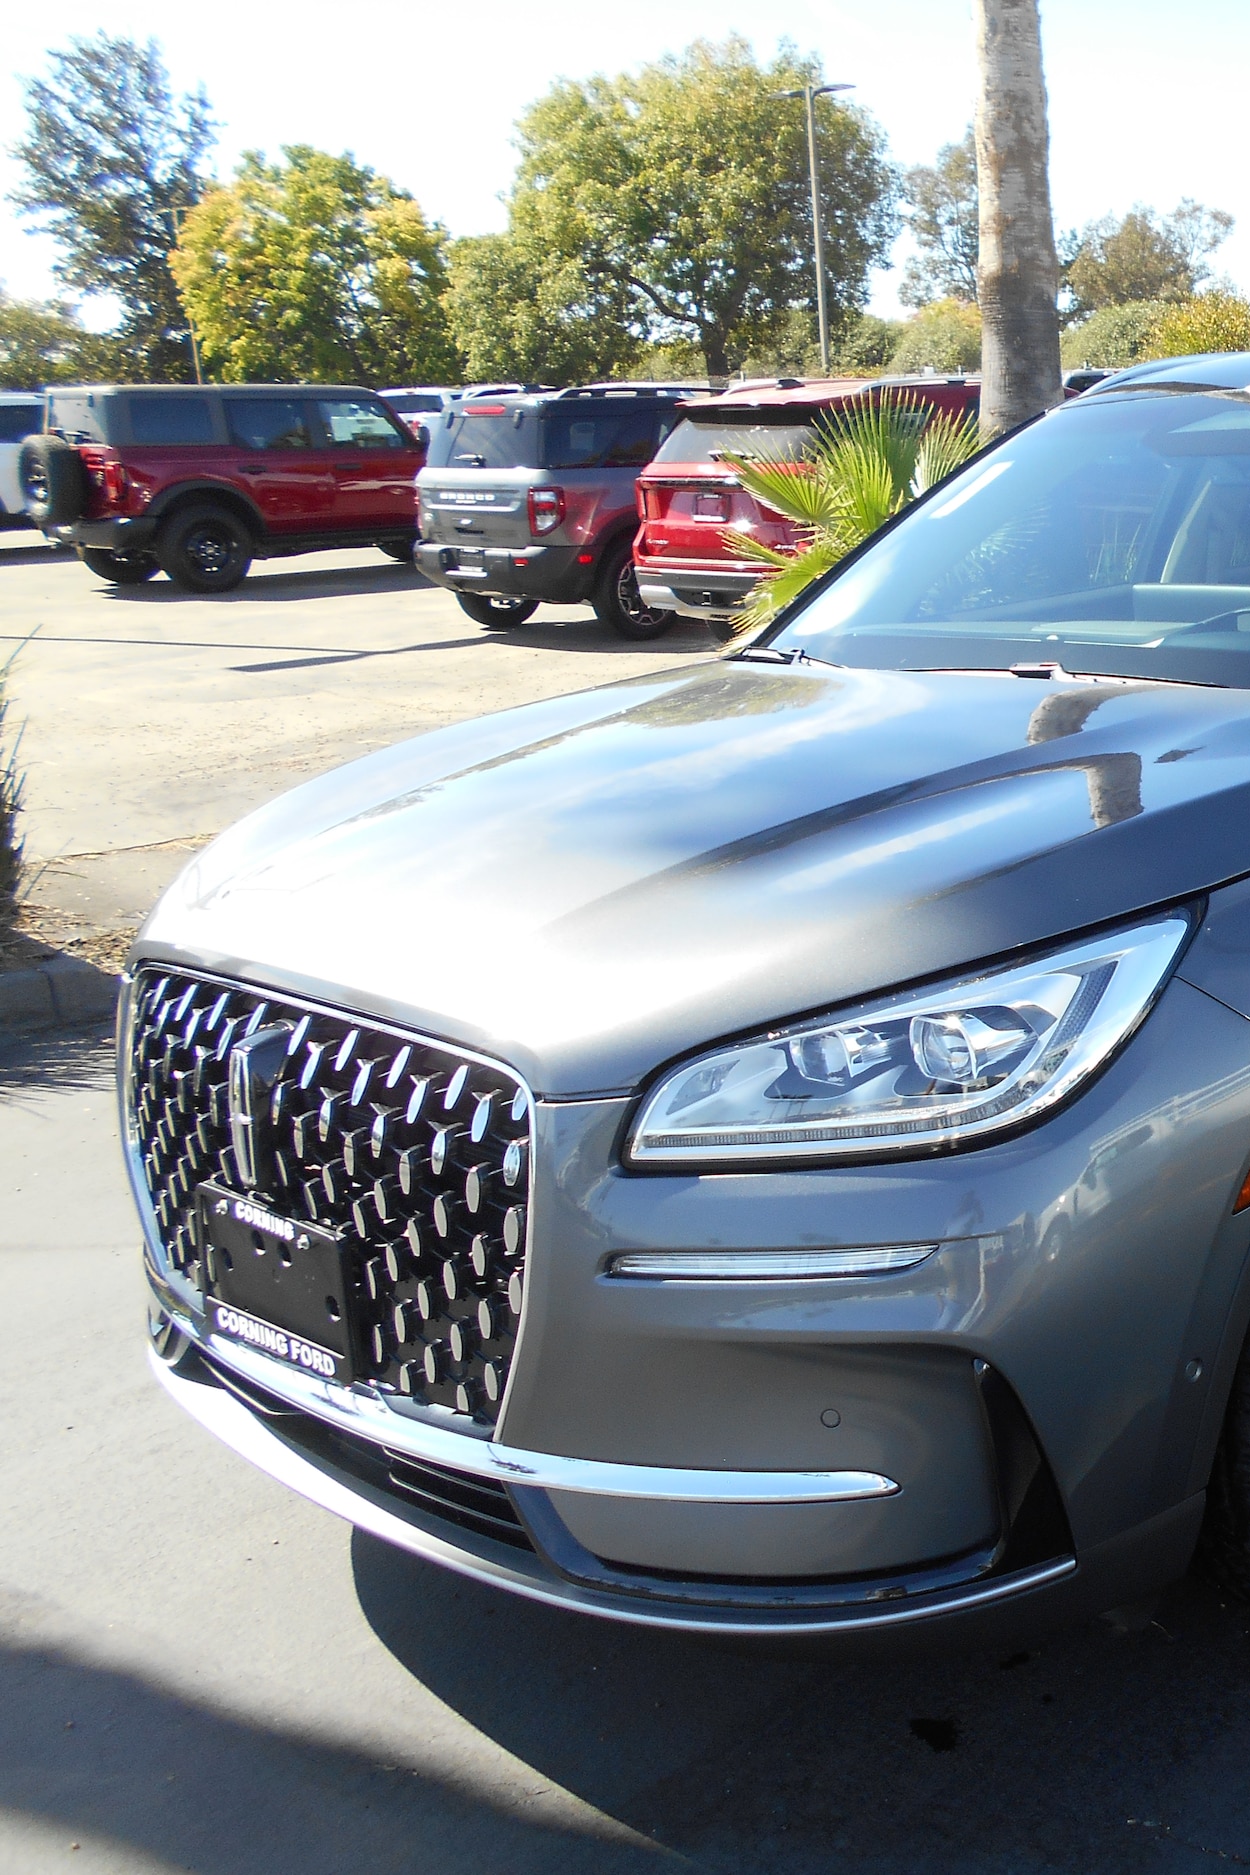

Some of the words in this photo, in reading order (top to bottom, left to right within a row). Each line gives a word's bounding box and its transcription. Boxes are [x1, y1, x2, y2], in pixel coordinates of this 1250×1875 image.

[234, 1201, 295, 1240] CORNING
[217, 1307, 289, 1354] CORNING
[290, 1339, 336, 1376] FORD
